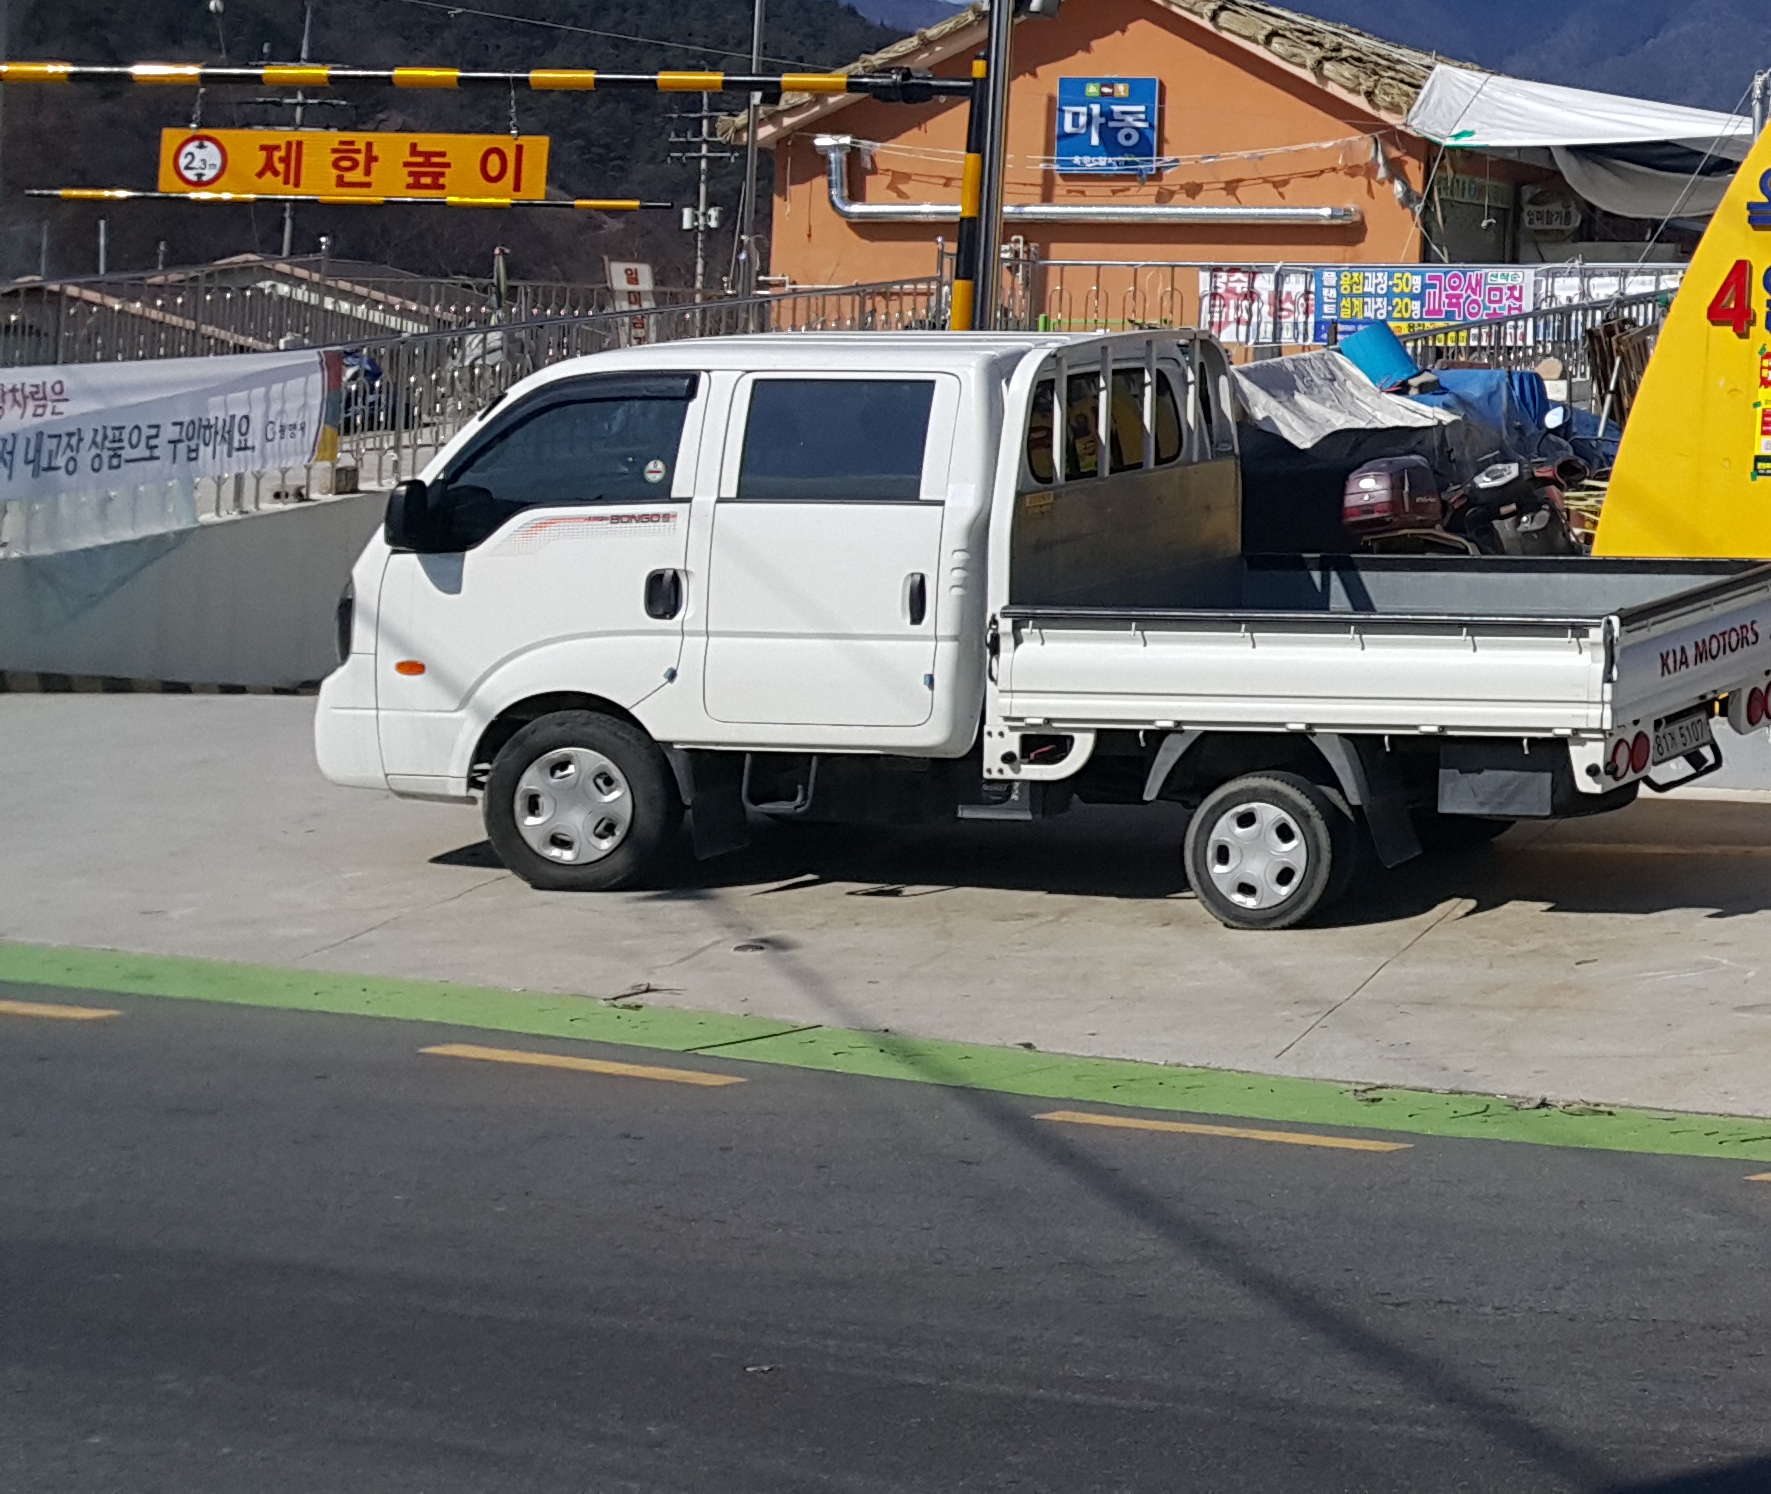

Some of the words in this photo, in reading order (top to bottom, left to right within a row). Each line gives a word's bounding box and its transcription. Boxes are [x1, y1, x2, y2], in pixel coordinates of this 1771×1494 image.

[1062, 103, 1150, 147] 마동
[255, 139, 523, 193] 제한높이
[23, 426, 84, 479] 내고장
[88, 423, 160, 473] 상품으로
[1659, 645, 1690, 678] KIA
[1694, 620, 1760, 666] MOTORS
